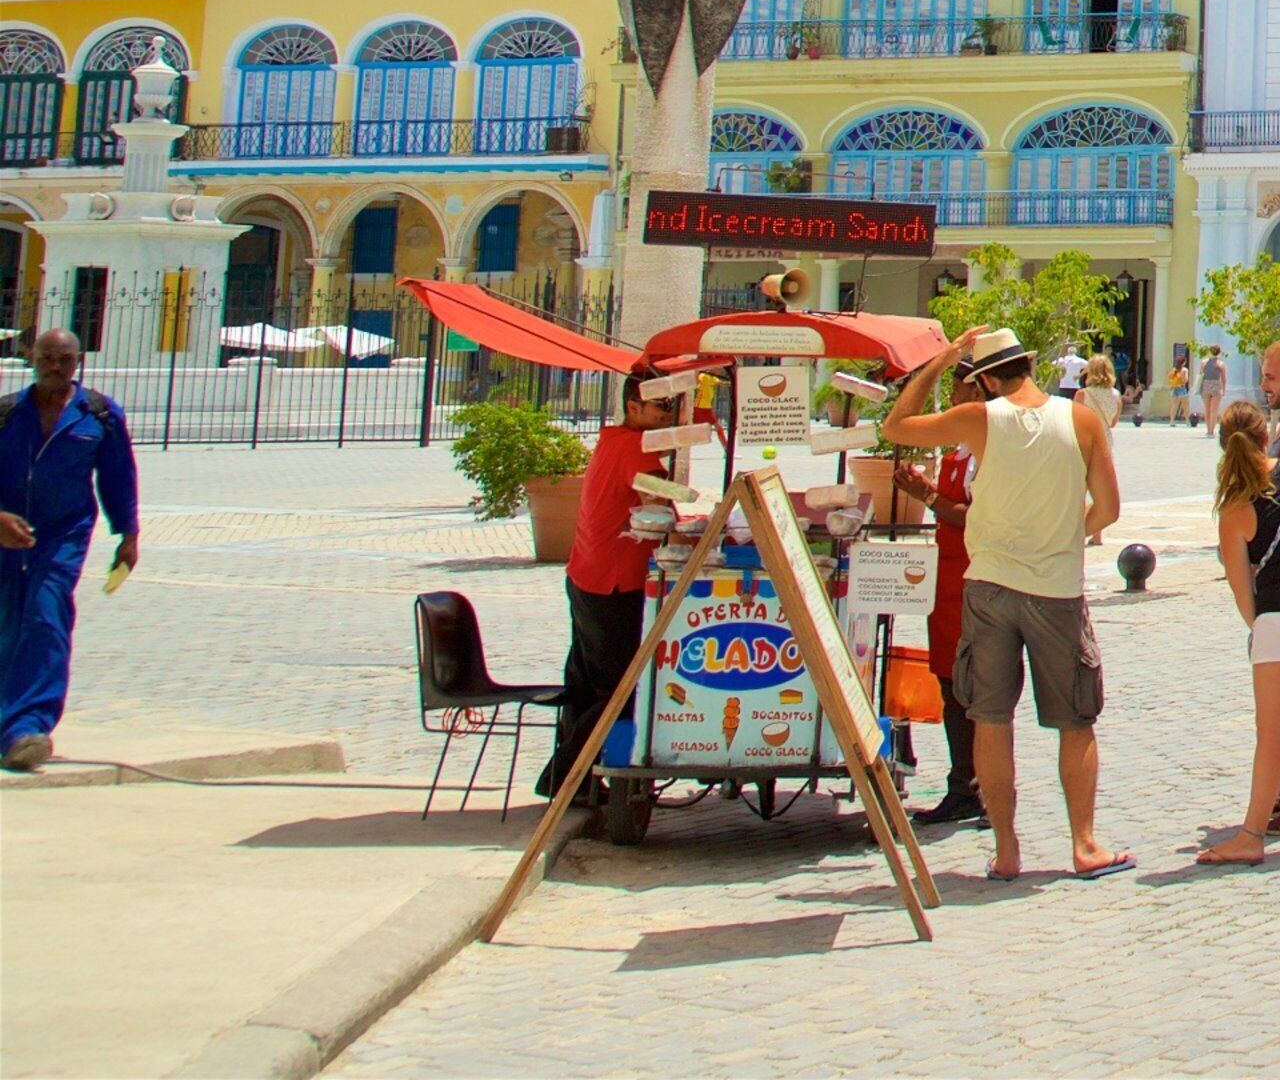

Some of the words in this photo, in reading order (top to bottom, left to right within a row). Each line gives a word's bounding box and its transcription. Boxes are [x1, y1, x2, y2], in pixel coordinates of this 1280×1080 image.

[695, 204, 836, 239] Icecream
[859, 550, 883, 558] COCO
[687, 602, 768, 627] OFERTA
[656, 637, 805, 673] HELADO
[657, 712, 705, 723] PALETAS
[751, 710, 814, 722] BOCADITOS
[670, 741, 719, 751] HELADOS
[744, 747, 773, 757] COCO
[775, 746, 810, 757] GLACE
